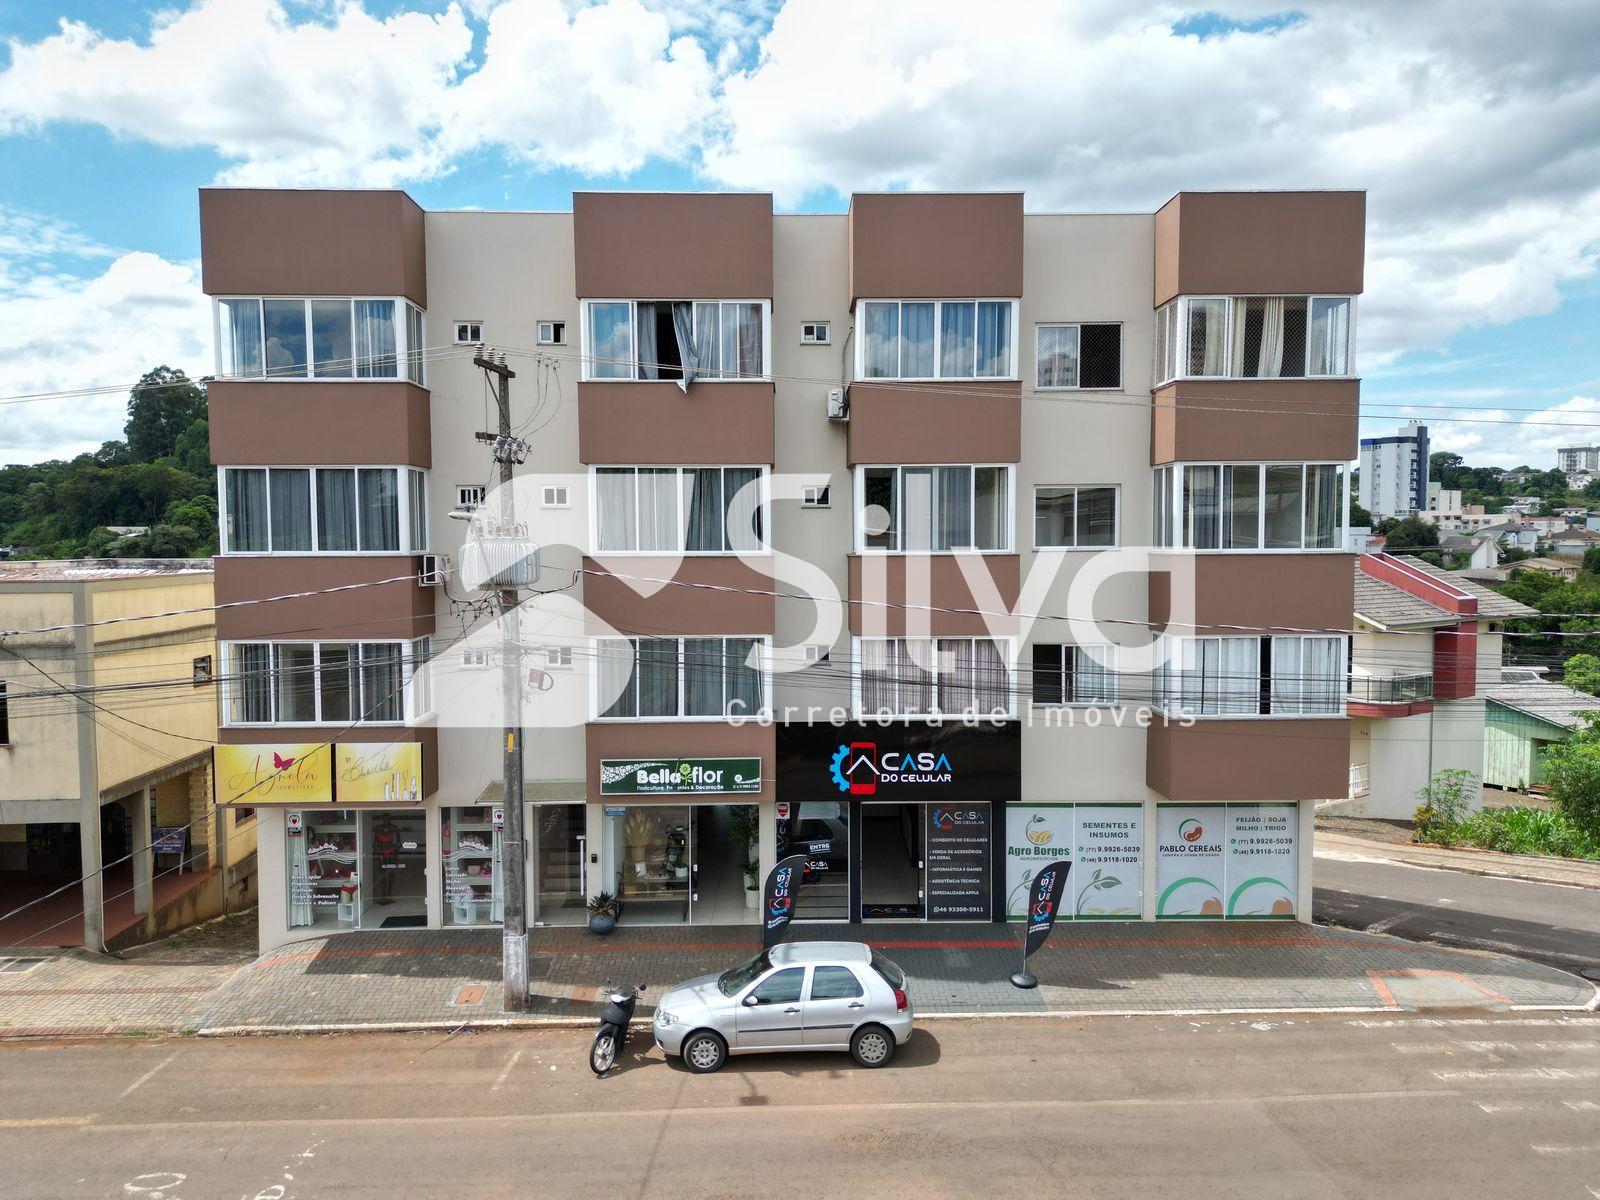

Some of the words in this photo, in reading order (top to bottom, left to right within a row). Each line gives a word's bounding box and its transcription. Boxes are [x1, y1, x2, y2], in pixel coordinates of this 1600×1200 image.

[881, 752, 953, 772] CASA
[636, 768, 682, 784] Bella
[691, 766, 724, 784] flor
[881, 773, 899, 783] DO
[900, 773, 952, 783] CELULAR
[1235, 815, 1261, 823] FEIJÃO
[1089, 831, 1129, 839] INSUMOS
[809, 842, 831, 851] ENTRE
[1159, 845, 1186, 853] PABLO
[1188, 845, 1222, 853] CEREAIS
[1007, 846, 1032, 857] Agro
[1033, 846, 1070, 857] Borges
